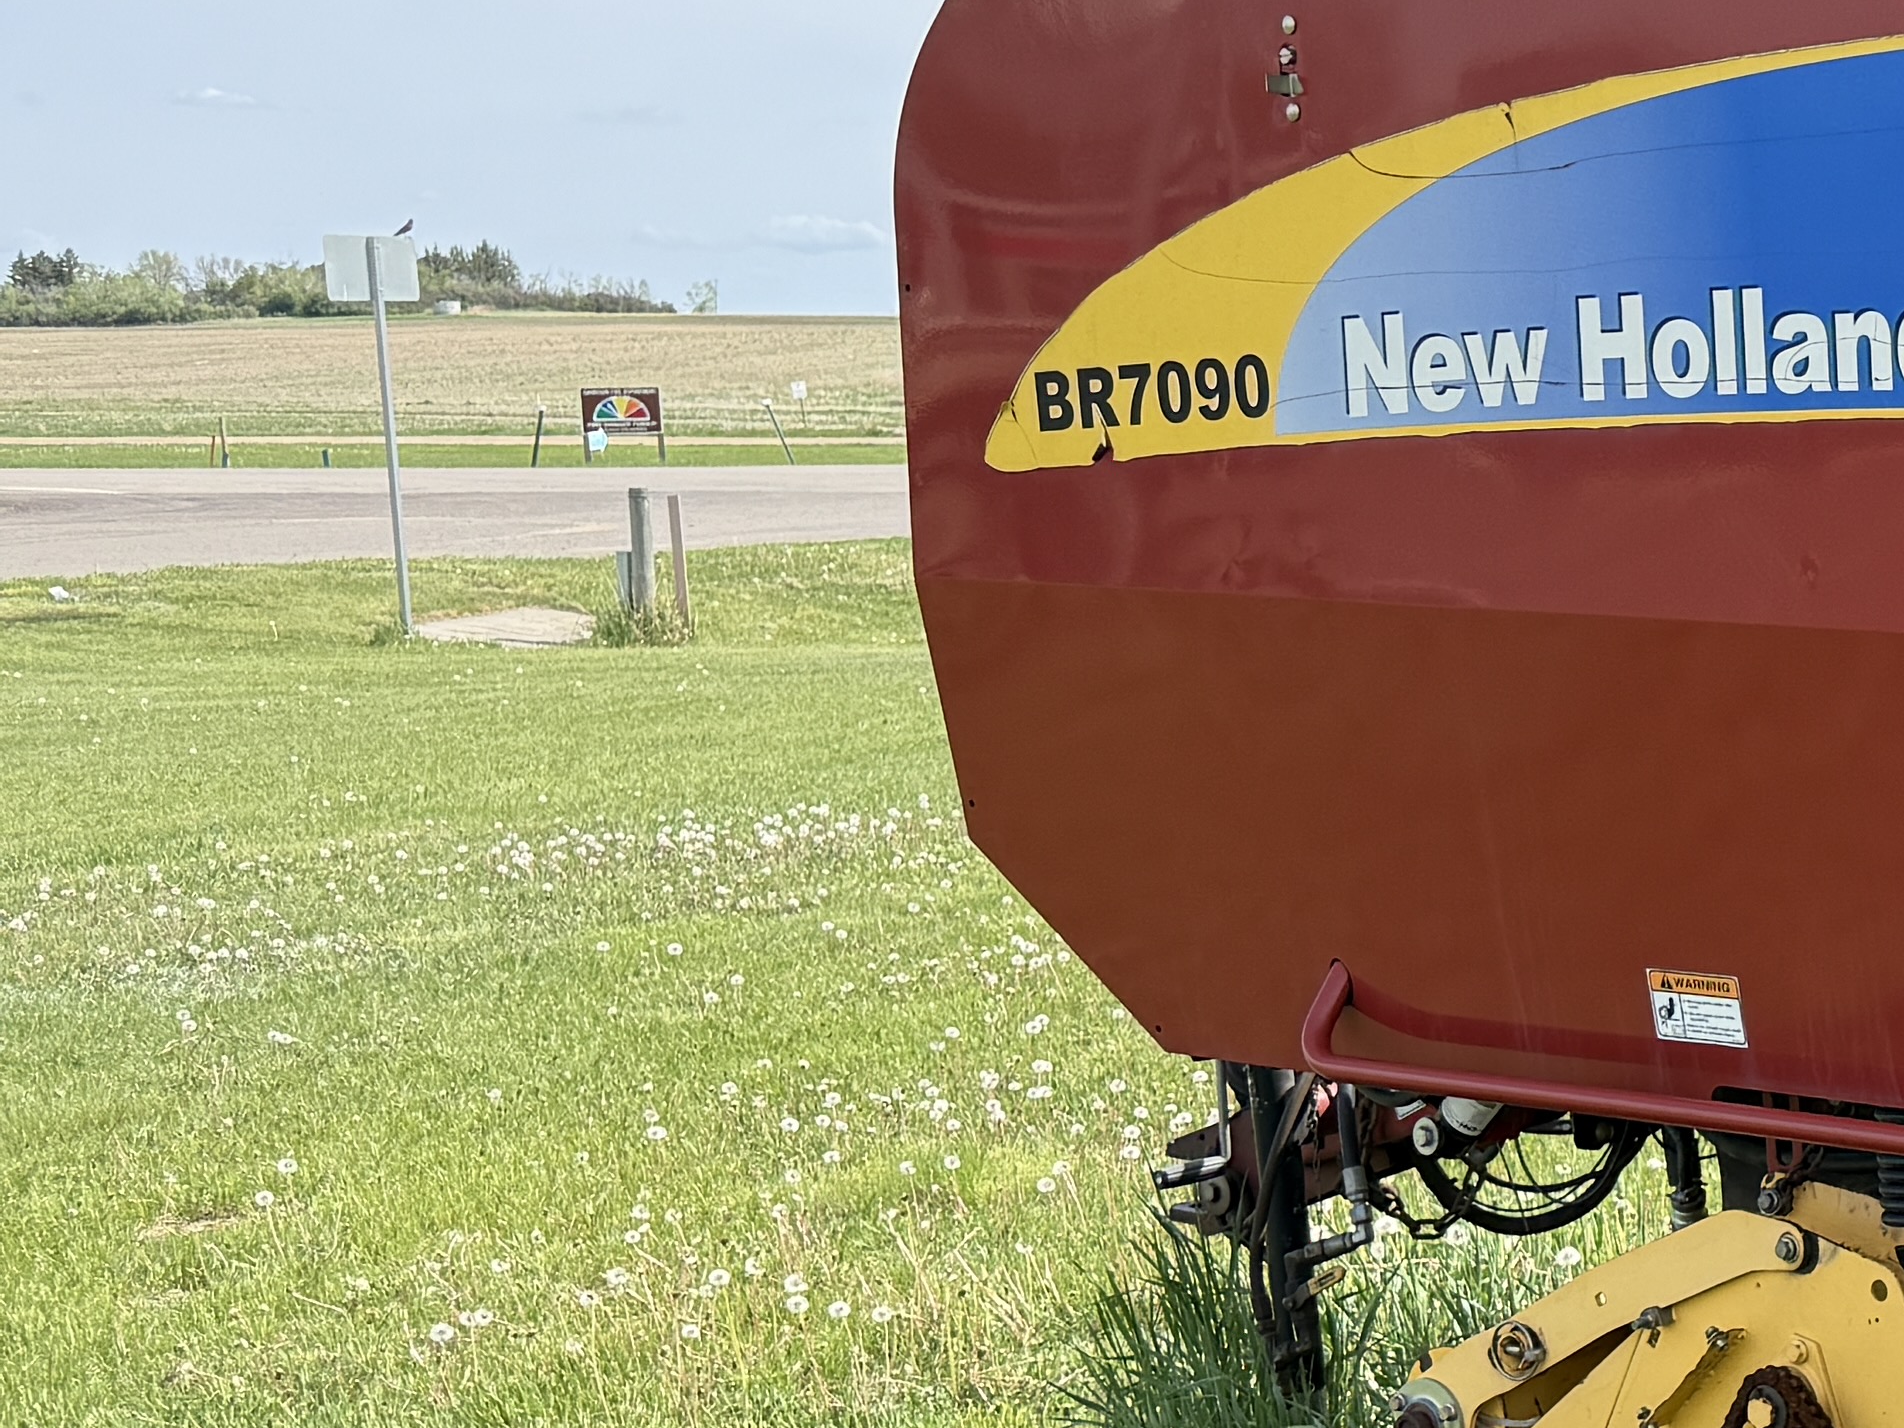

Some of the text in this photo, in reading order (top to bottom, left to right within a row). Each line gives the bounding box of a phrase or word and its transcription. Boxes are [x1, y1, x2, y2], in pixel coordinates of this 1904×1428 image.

[1034, 353, 1270, 433] BR7090
[1341, 310, 1549, 419] New
[1673, 976, 1731, 993] WARNING
